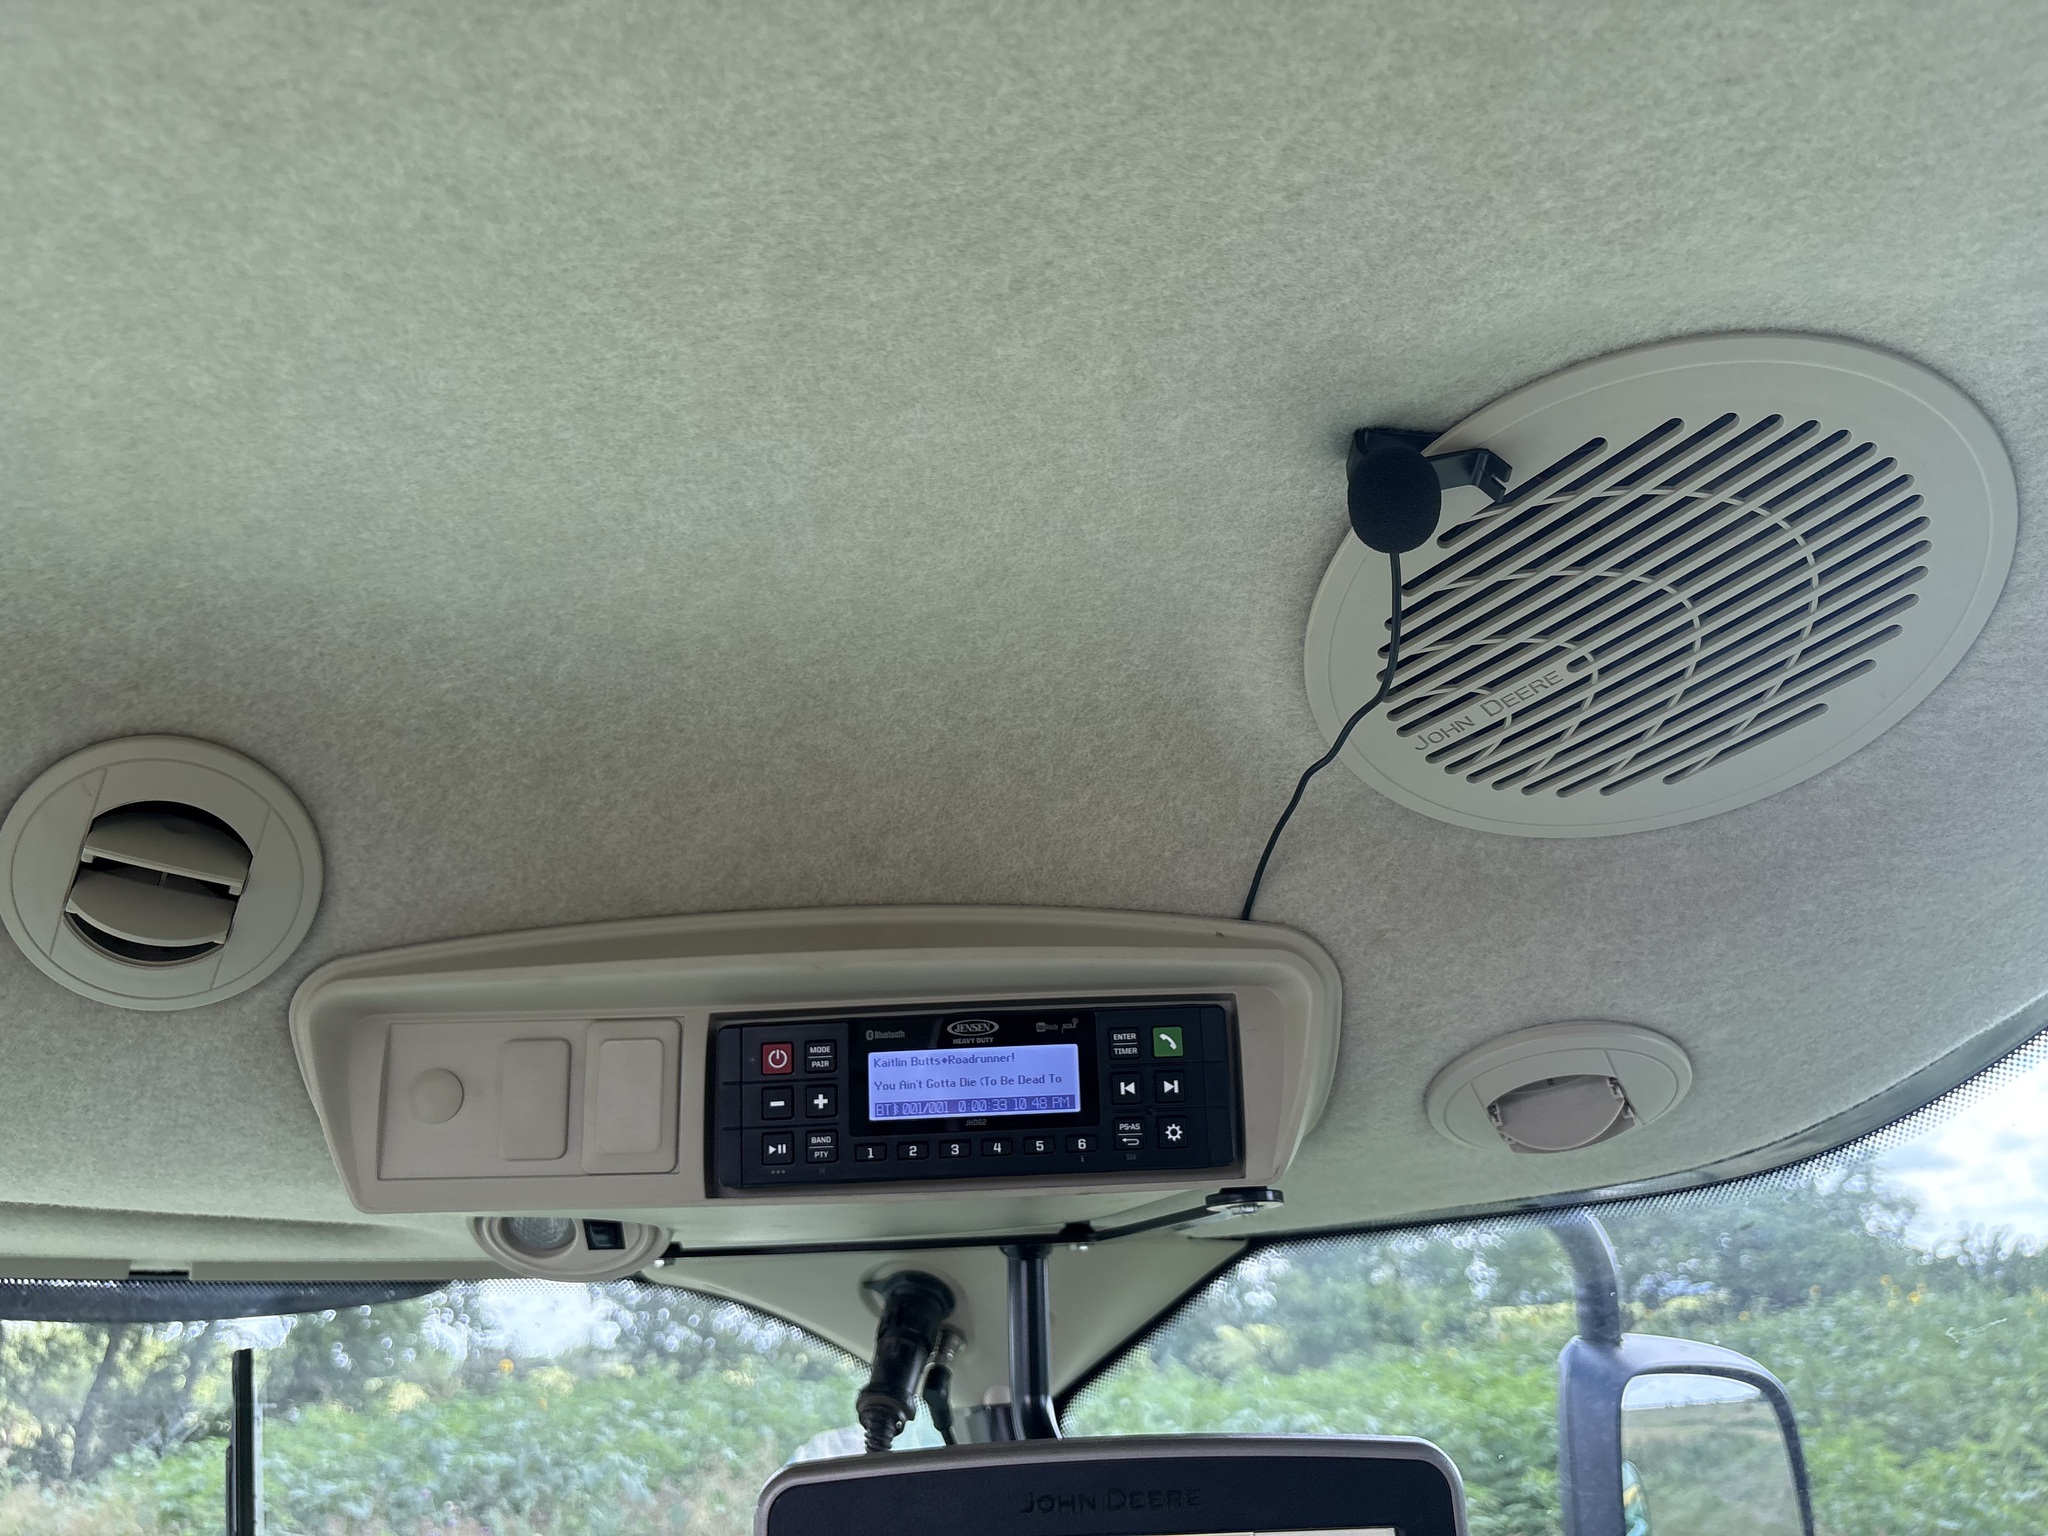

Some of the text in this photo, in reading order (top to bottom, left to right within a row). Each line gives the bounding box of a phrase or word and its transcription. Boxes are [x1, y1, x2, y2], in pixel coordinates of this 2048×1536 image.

[1414, 670, 1563, 751] JOHN DEERE
[954, 1022, 991, 1033] JENSEN
[976, 1036, 994, 1044] DUTY
[1113, 1033, 1137, 1041] ENTER
[809, 1045, 831, 1054] MODE
[1114, 1047, 1138, 1055] TIMER
[811, 1060, 830, 1068] PAIR
[873, 1057, 907, 1068] Kaitlin
[911, 1056, 941, 1067] Butts
[874, 1073, 1063, 1091] You Ain't Gotta Die (To Be Dead To
[1052, 1096, 1070, 1108] PM
[811, 1136, 831, 1144] BAND
[1035, 1140, 1045, 1152] 5
[1077, 1138, 1087, 1150] 6
[867, 1147, 875, 1159] 1
[908, 1145, 918, 1157] 2
[950, 1143, 960, 1155] 3
[992, 1142, 1002, 1153] 4
[814, 1150, 829, 1158] PTY
[1021, 1487, 1201, 1514] JOHN DEERE
